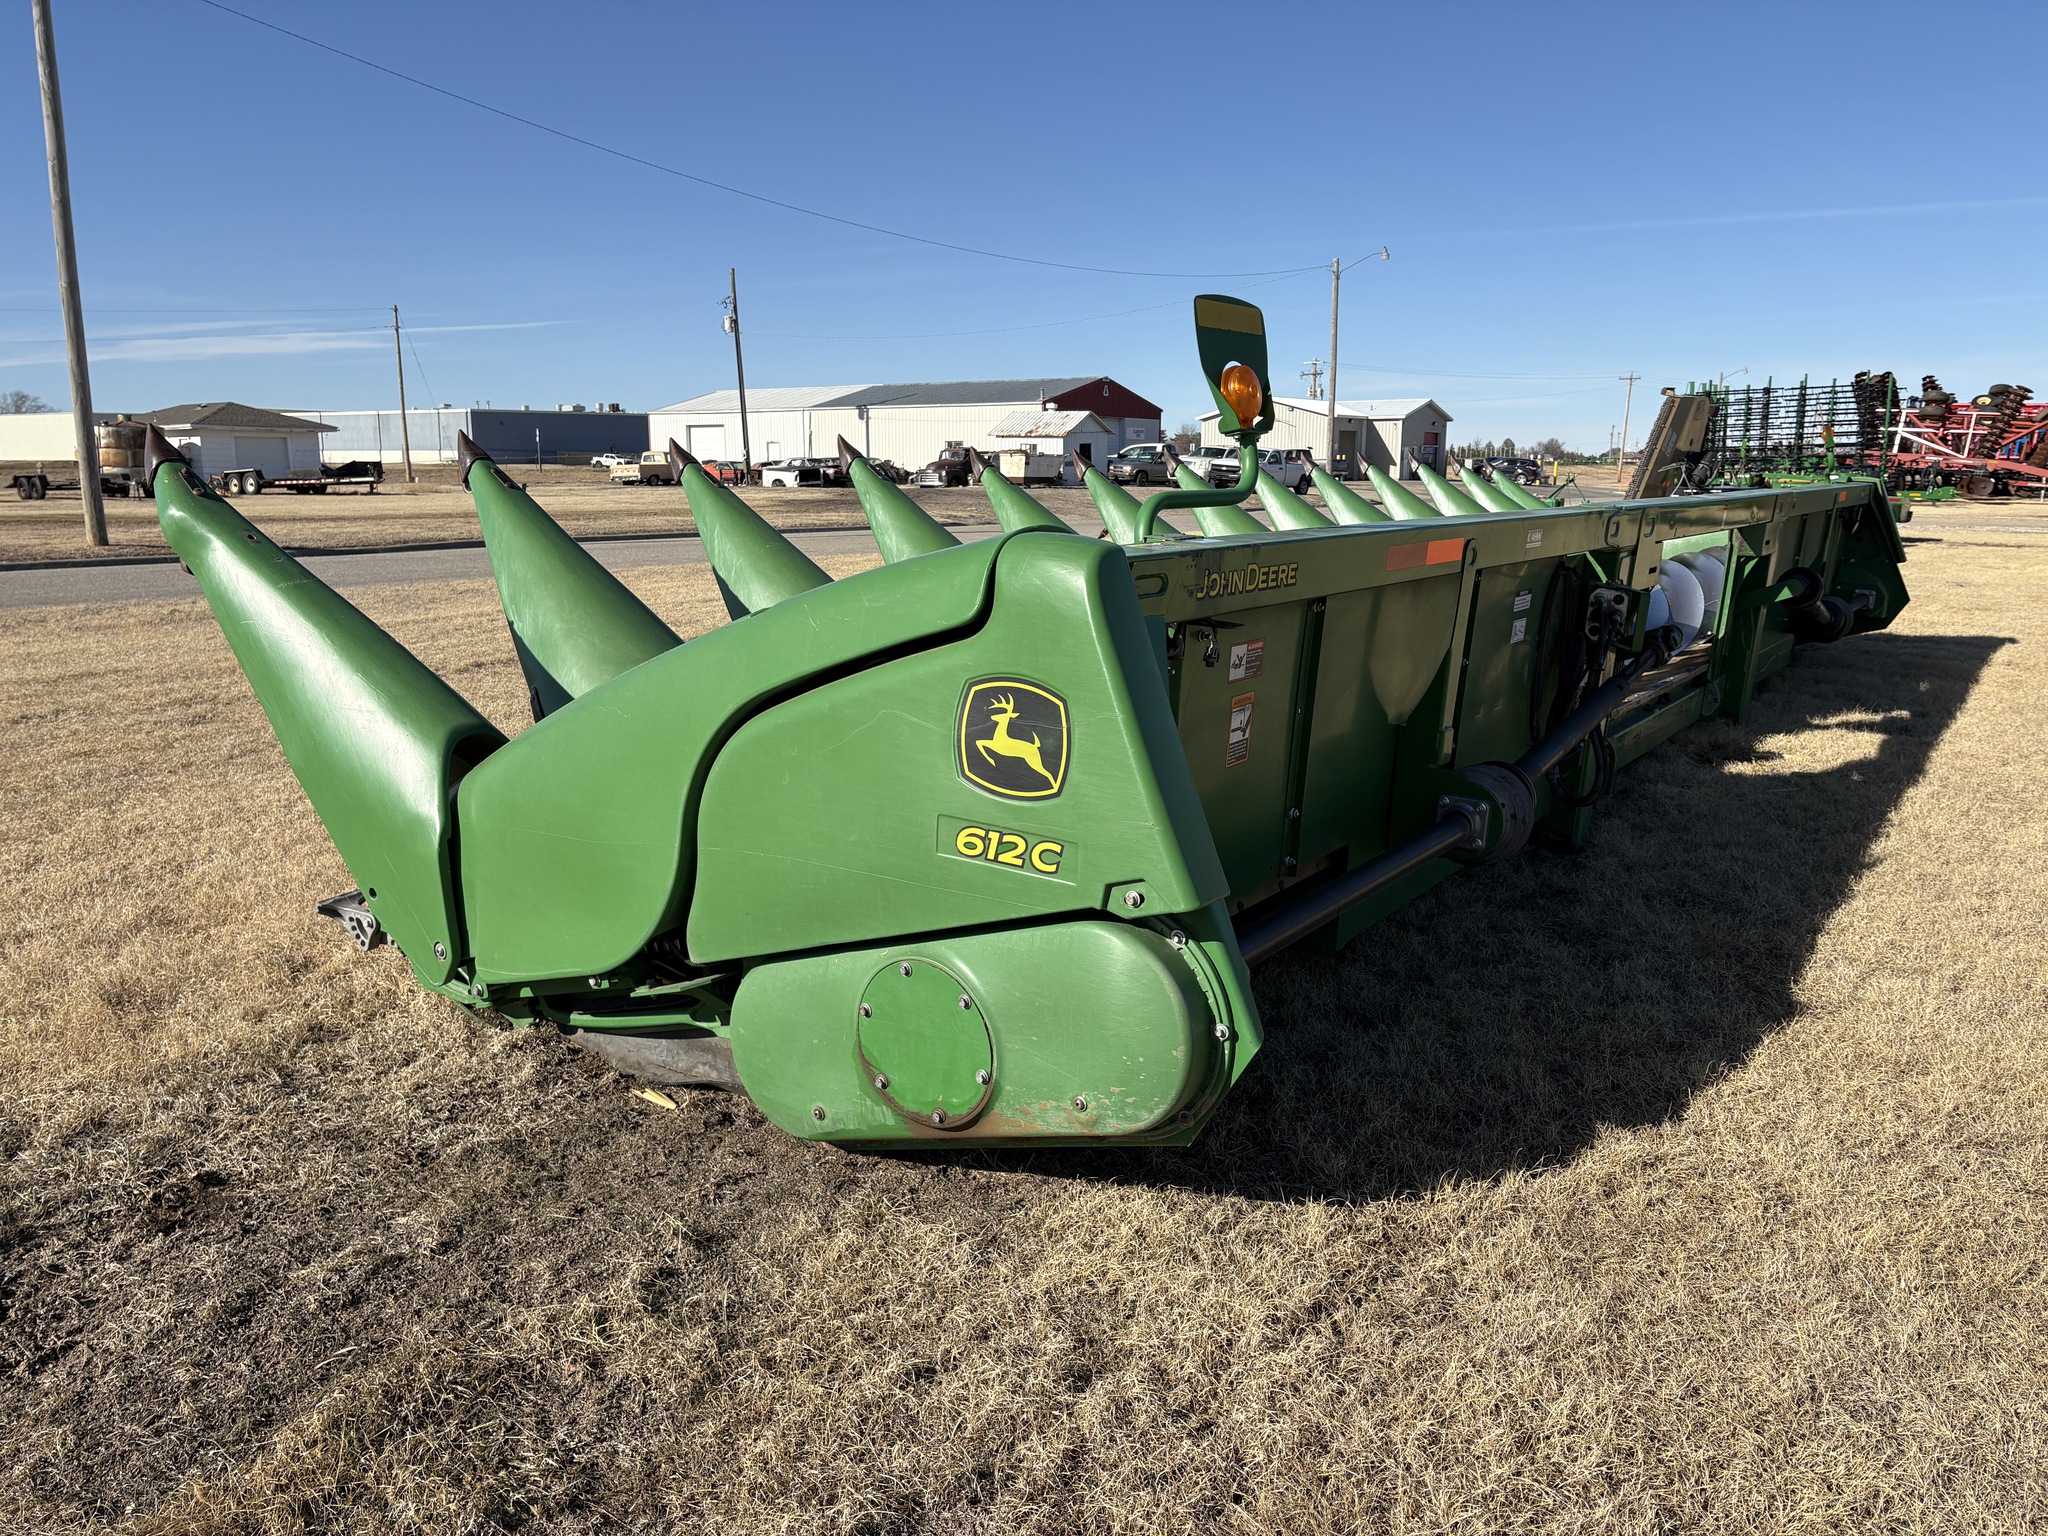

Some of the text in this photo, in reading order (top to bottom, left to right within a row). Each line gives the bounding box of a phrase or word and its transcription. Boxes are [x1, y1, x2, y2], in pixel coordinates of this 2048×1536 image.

[1196, 562, 1298, 600] JOHN DEERE
[956, 826, 1065, 874] 612C
